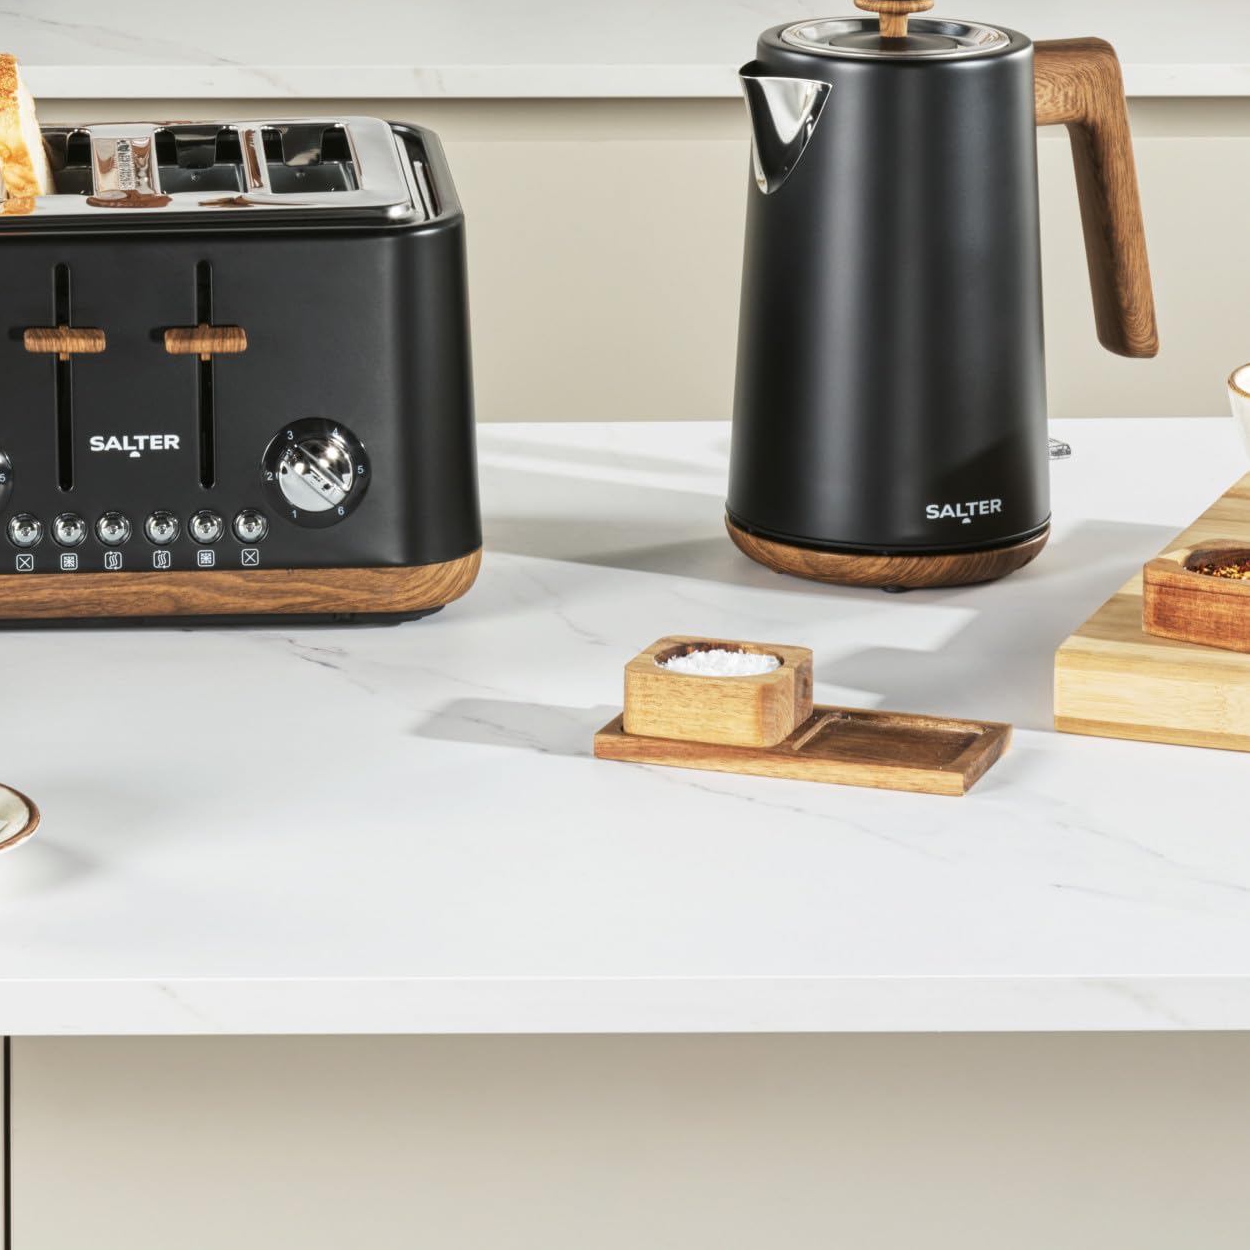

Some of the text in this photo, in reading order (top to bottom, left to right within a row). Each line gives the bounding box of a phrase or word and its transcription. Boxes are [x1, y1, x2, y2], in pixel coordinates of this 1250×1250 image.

[287, 430, 294, 440] 3
[89, 434, 181, 452] SALTER
[357, 465, 365, 475] 5
[0, 474, 6, 483] 5
[266, 471, 274, 481] 2
[337, 506, 345, 516] 6
[925, 498, 1002, 520] SALTER
[292, 510, 297, 519] 1
